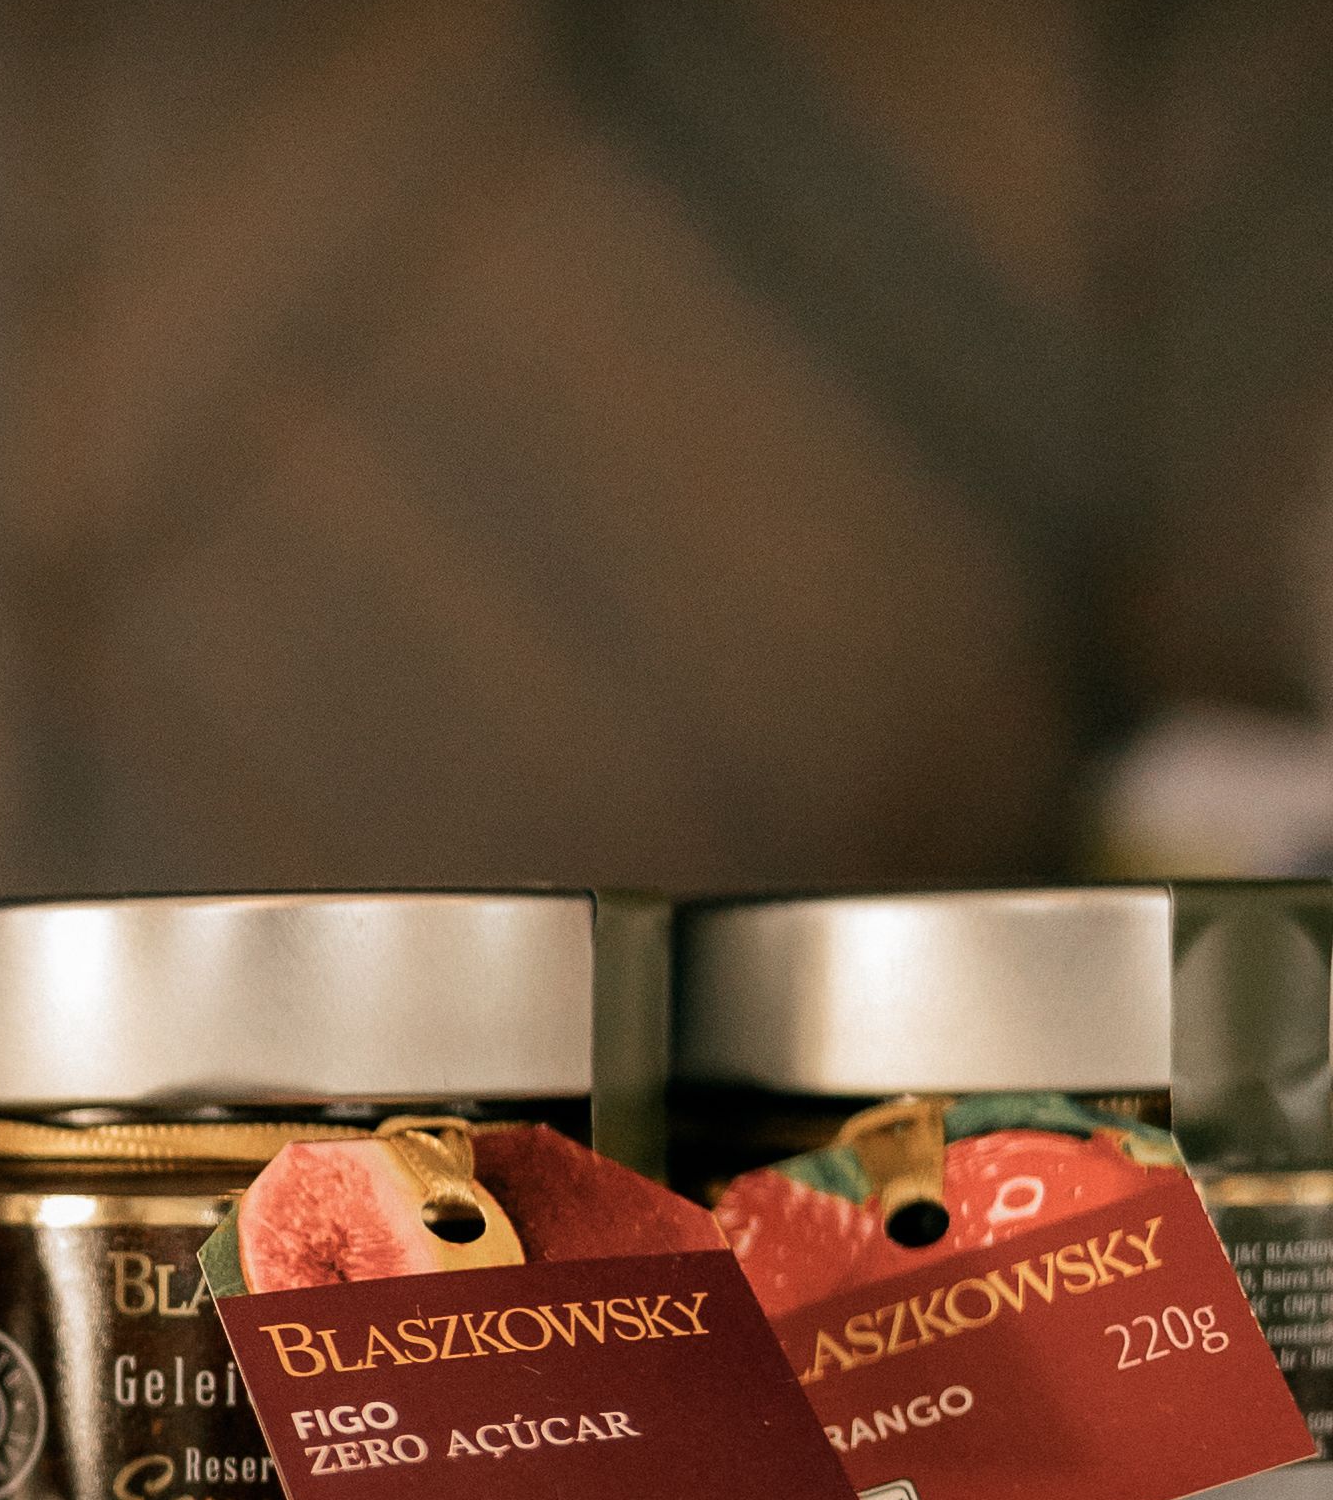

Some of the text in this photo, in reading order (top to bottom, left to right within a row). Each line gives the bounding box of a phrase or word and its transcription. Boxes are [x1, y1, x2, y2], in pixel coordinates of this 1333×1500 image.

[799, 1215, 1164, 1386] ASZKOWSKY
[258, 1291, 710, 1379] BLASZKOWSKY
[1103, 1303, 1231, 1372] 220g
[114, 1354, 250, 1408] Gelei
[290, 1400, 399, 1441] FIGO
[304, 1411, 642, 1477] ZERO AÇÚCAR
